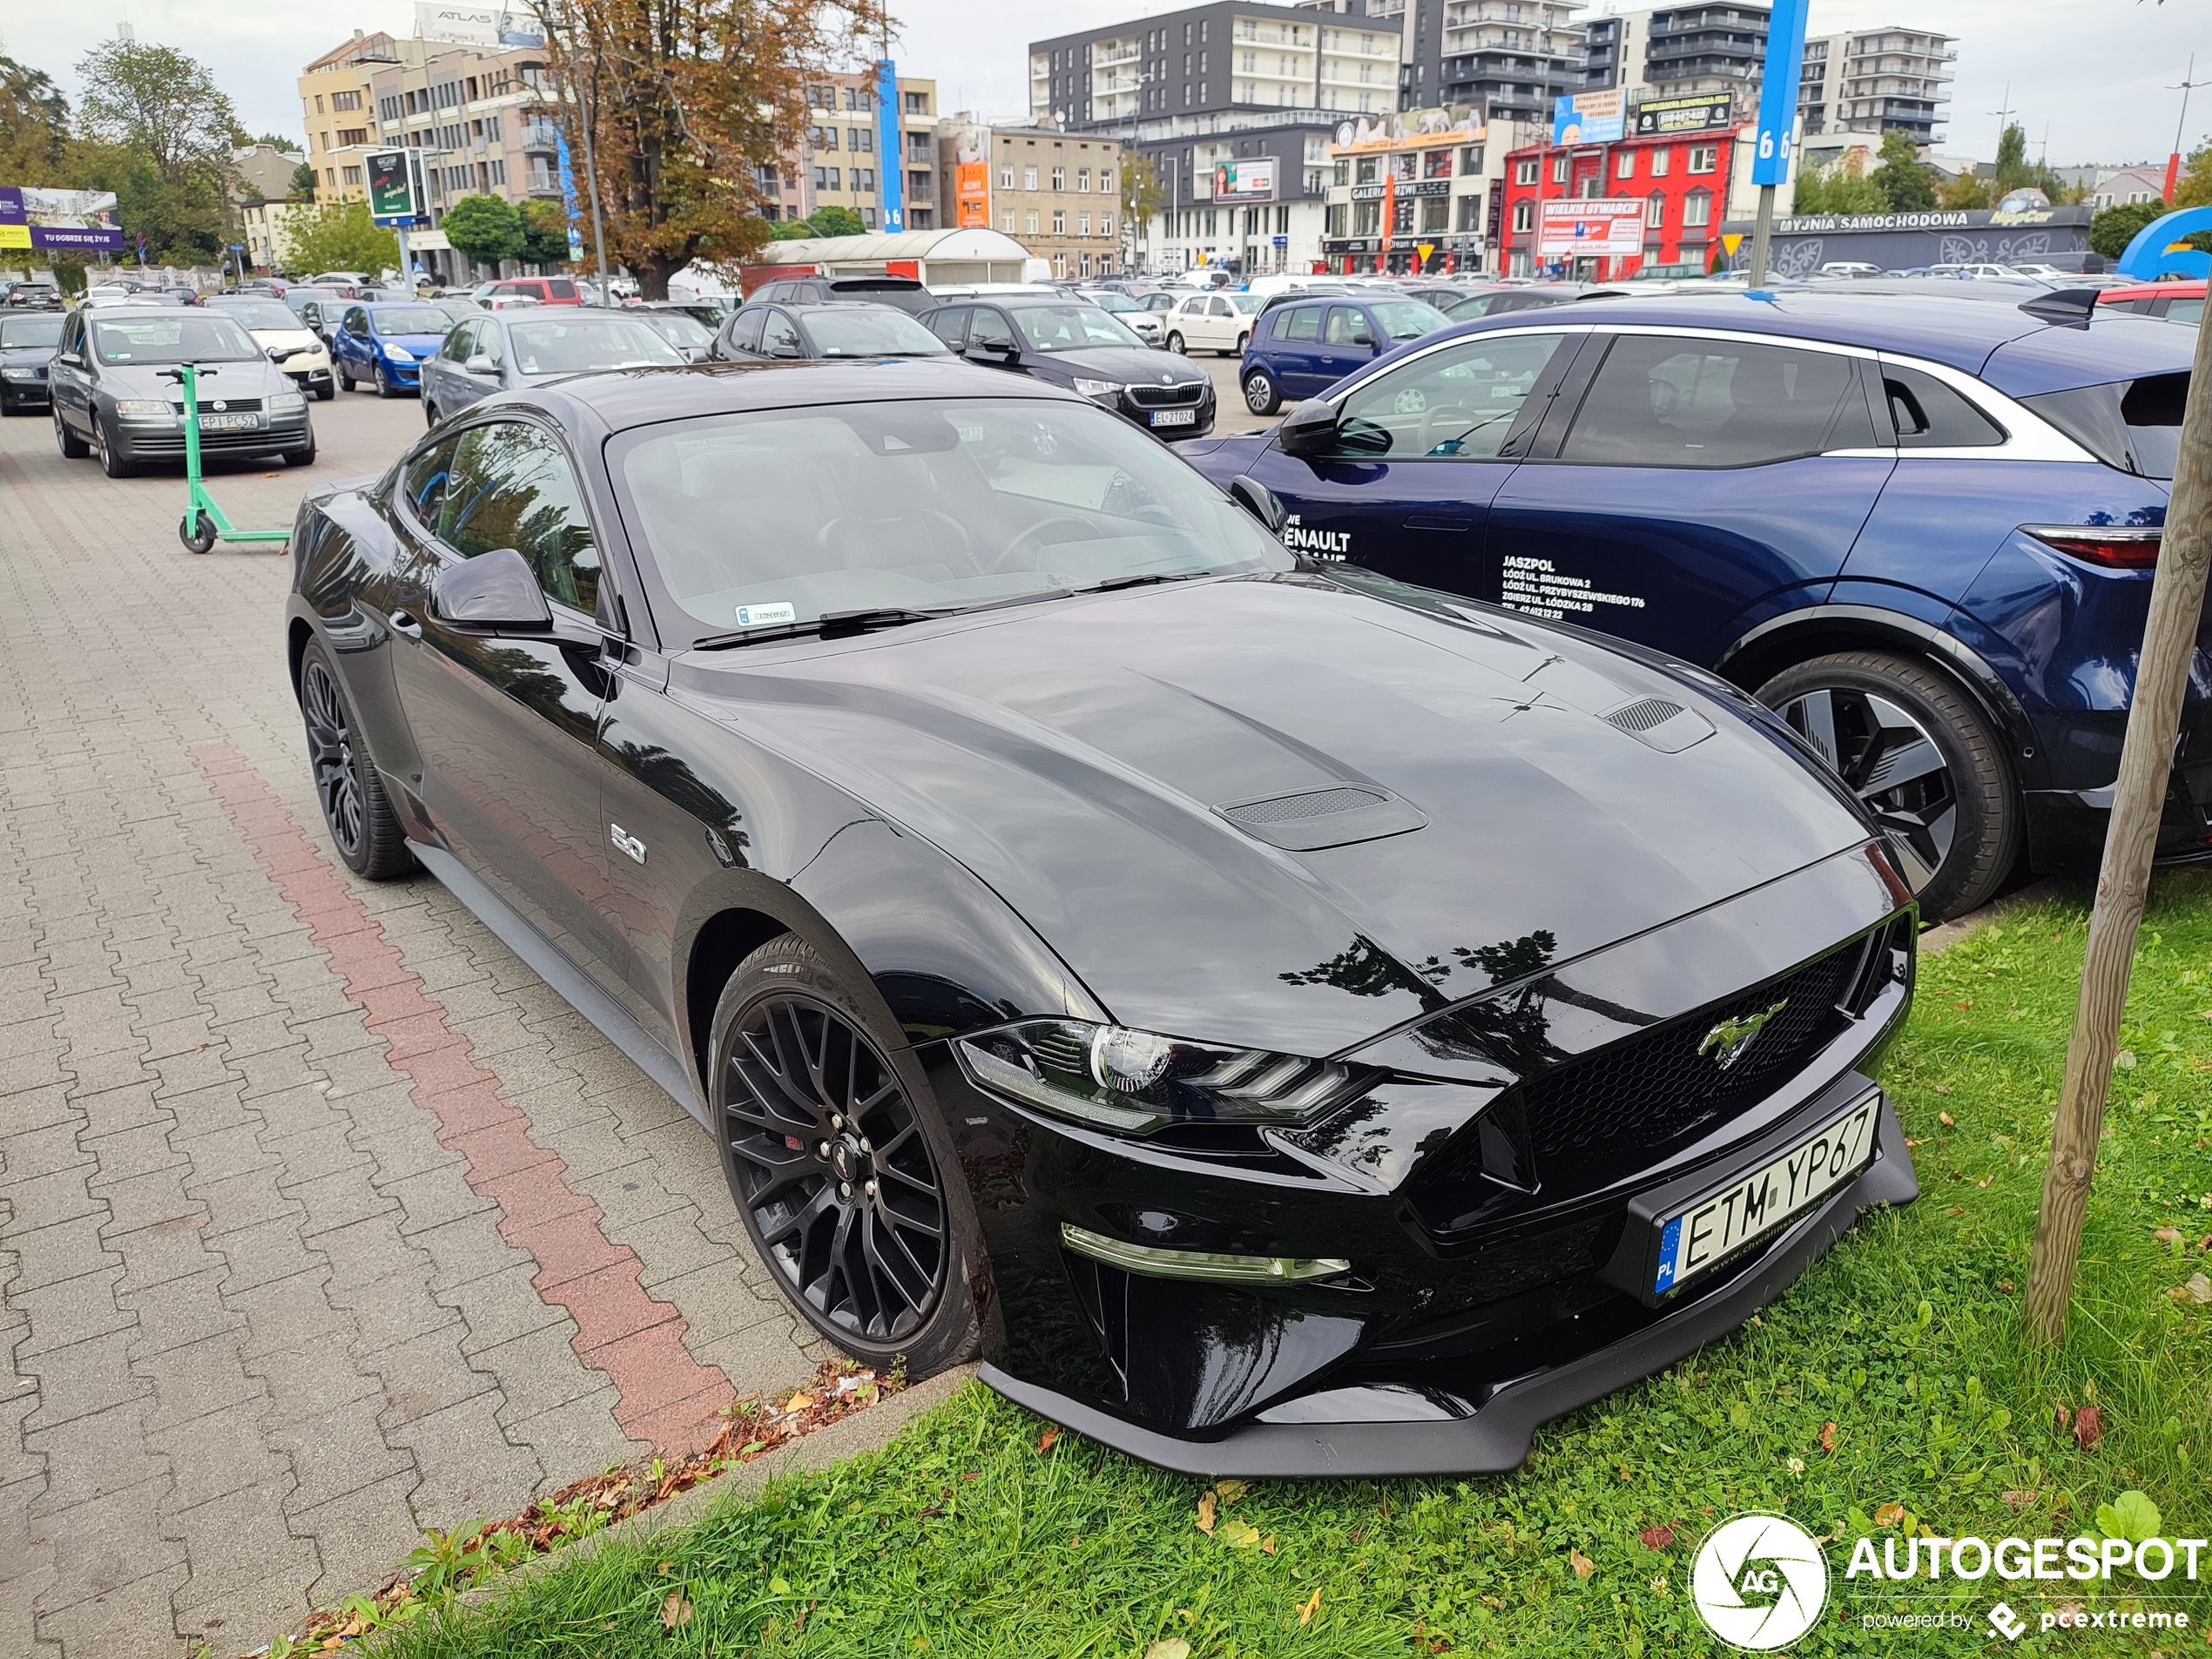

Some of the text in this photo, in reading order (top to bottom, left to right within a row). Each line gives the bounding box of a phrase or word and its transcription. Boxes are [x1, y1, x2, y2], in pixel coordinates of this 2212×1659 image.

[438, 11, 491, 24] ATLAS
[1759, 130, 1774, 160] 6
[1780, 130, 1791, 160] 6
[1352, 185, 1386, 199] GALERIA
[1394, 183, 1416, 197] RZWI
[893, 208, 901, 226] 6
[1546, 201, 1641, 216] WIELKIE OTWARCIE
[1988, 209, 2054, 226] HippCar
[1779, 212, 1968, 232] MYJNIA SAMOCHODOWA
[201, 415, 255, 428] EPI PC52
[1156, 411, 1193, 423] EL 2T024
[1287, 513, 1301, 525] WE
[1284, 527, 1352, 553] ENAULT
[1502, 555, 1556, 572] JASZPOL
[1502, 568, 1526, 580] ŁÓDŹ
[1540, 574, 1584, 588] BRUKOWA
[1584, 579, 1592, 589] 2
[1501, 590, 1532, 604] ZGIERZ
[1545, 596, 1581, 611] ŁÓDZKA
[1581, 602, 1594, 612] 28
[1502, 579, 1526, 591] ŁÓDŹ
[1539, 584, 1631, 606] PRZYBYSZEWSKIEGO
[1630, 597, 1646, 608] 176
[1529, 606, 1543, 617] 612
[1542, 609, 1552, 618] 12
[1552, 610, 1564, 620] 22
[1683, 1106, 1870, 1271] ETM YP67
[1657, 1260, 1674, 1281] PL
